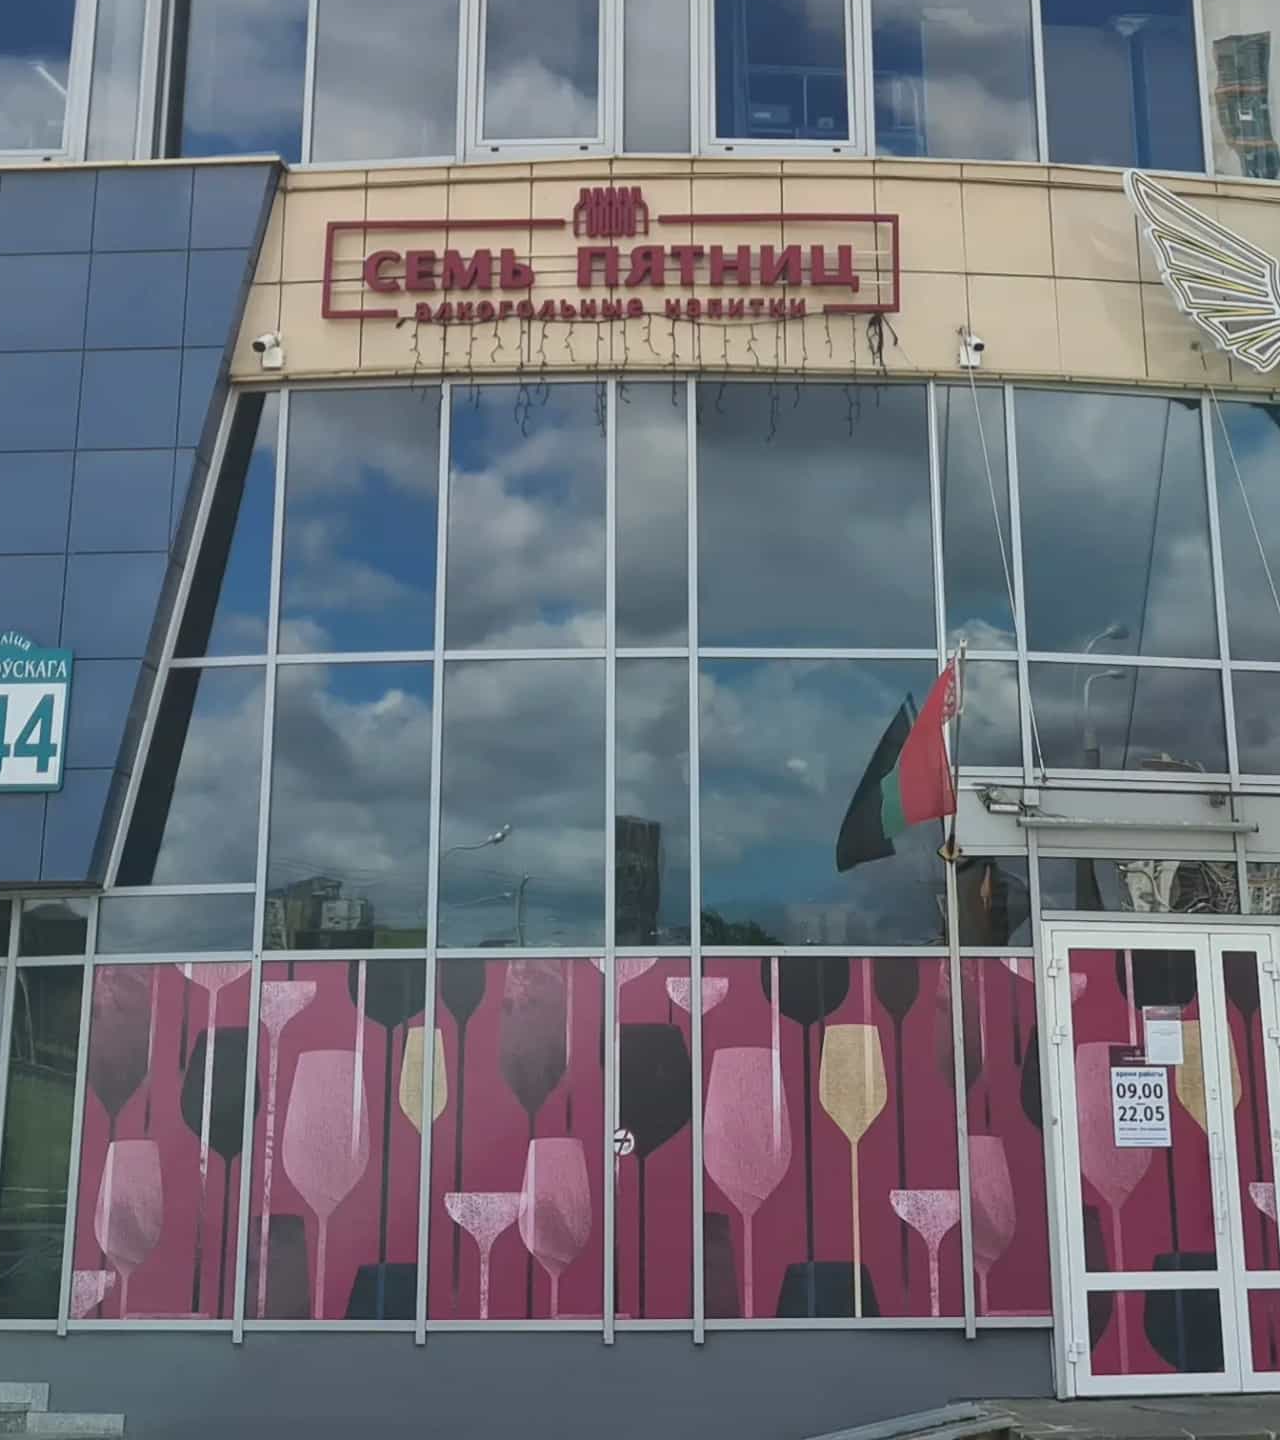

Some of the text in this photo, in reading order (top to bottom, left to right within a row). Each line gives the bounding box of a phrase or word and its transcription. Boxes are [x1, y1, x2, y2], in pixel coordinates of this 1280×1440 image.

[363, 245, 859, 293] СЕМЬ ПЯТНИЦ
[415, 297, 807, 322] алкогольные напитки
[1116, 1083, 1163, 1099] 09.00
[1118, 1105, 1165, 1122] 22.05
